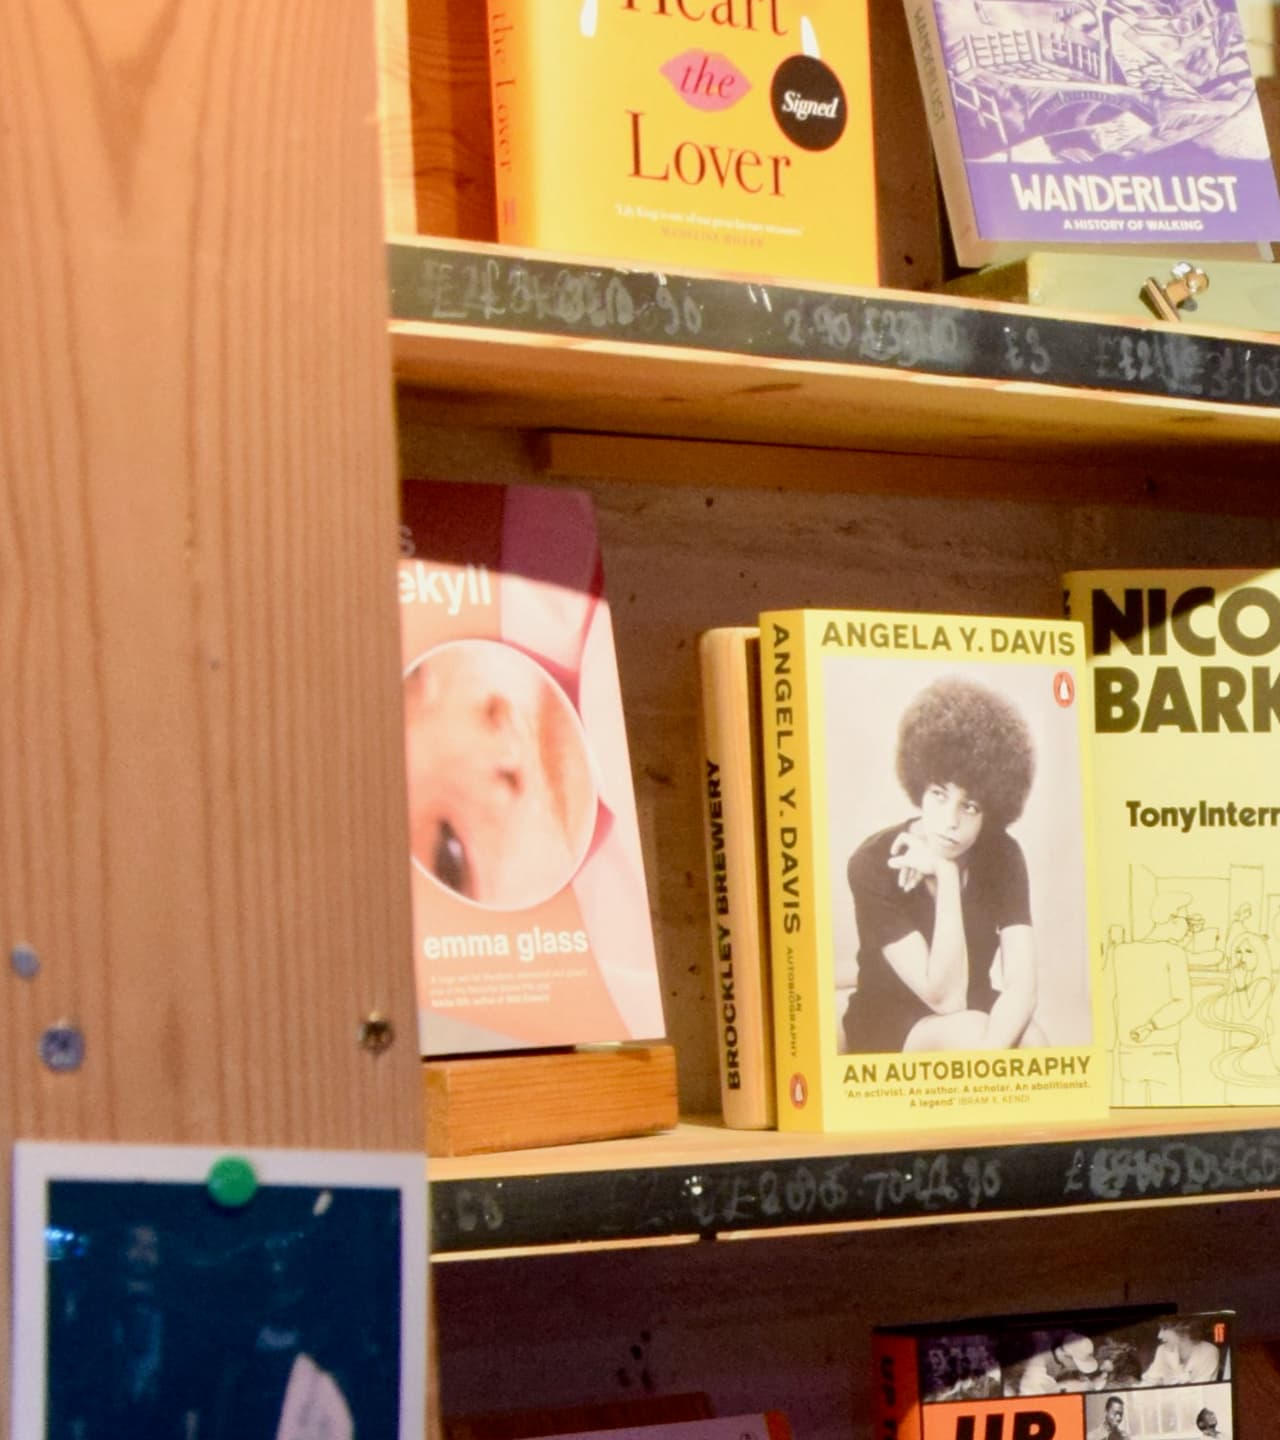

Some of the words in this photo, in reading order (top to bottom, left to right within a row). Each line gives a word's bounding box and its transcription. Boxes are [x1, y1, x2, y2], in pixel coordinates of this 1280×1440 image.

[679, 57, 737, 103] the
[624, 110, 792, 199] Lover
[1011, 173, 1239, 214] WANDERLUST
[1063, 219, 1073, 229] A
[1074, 219, 1124, 231] HISTORY
[1128, 219, 1144, 231] OF
[1146, 220, 1204, 232] WALKING
[821, 620, 952, 652] ANGELA
[960, 625, 984, 653] Y.
[991, 628, 1076, 656] DAVIS
[706, 760, 731, 917] BREWERY
[422, 925, 509, 961] emma
[517, 922, 589, 959] glass
[715, 923, 741, 1091] BROCKLEY
[843, 1062, 877, 1085] AN
[885, 1055, 1091, 1082] AUTOBIOGRAPHY
